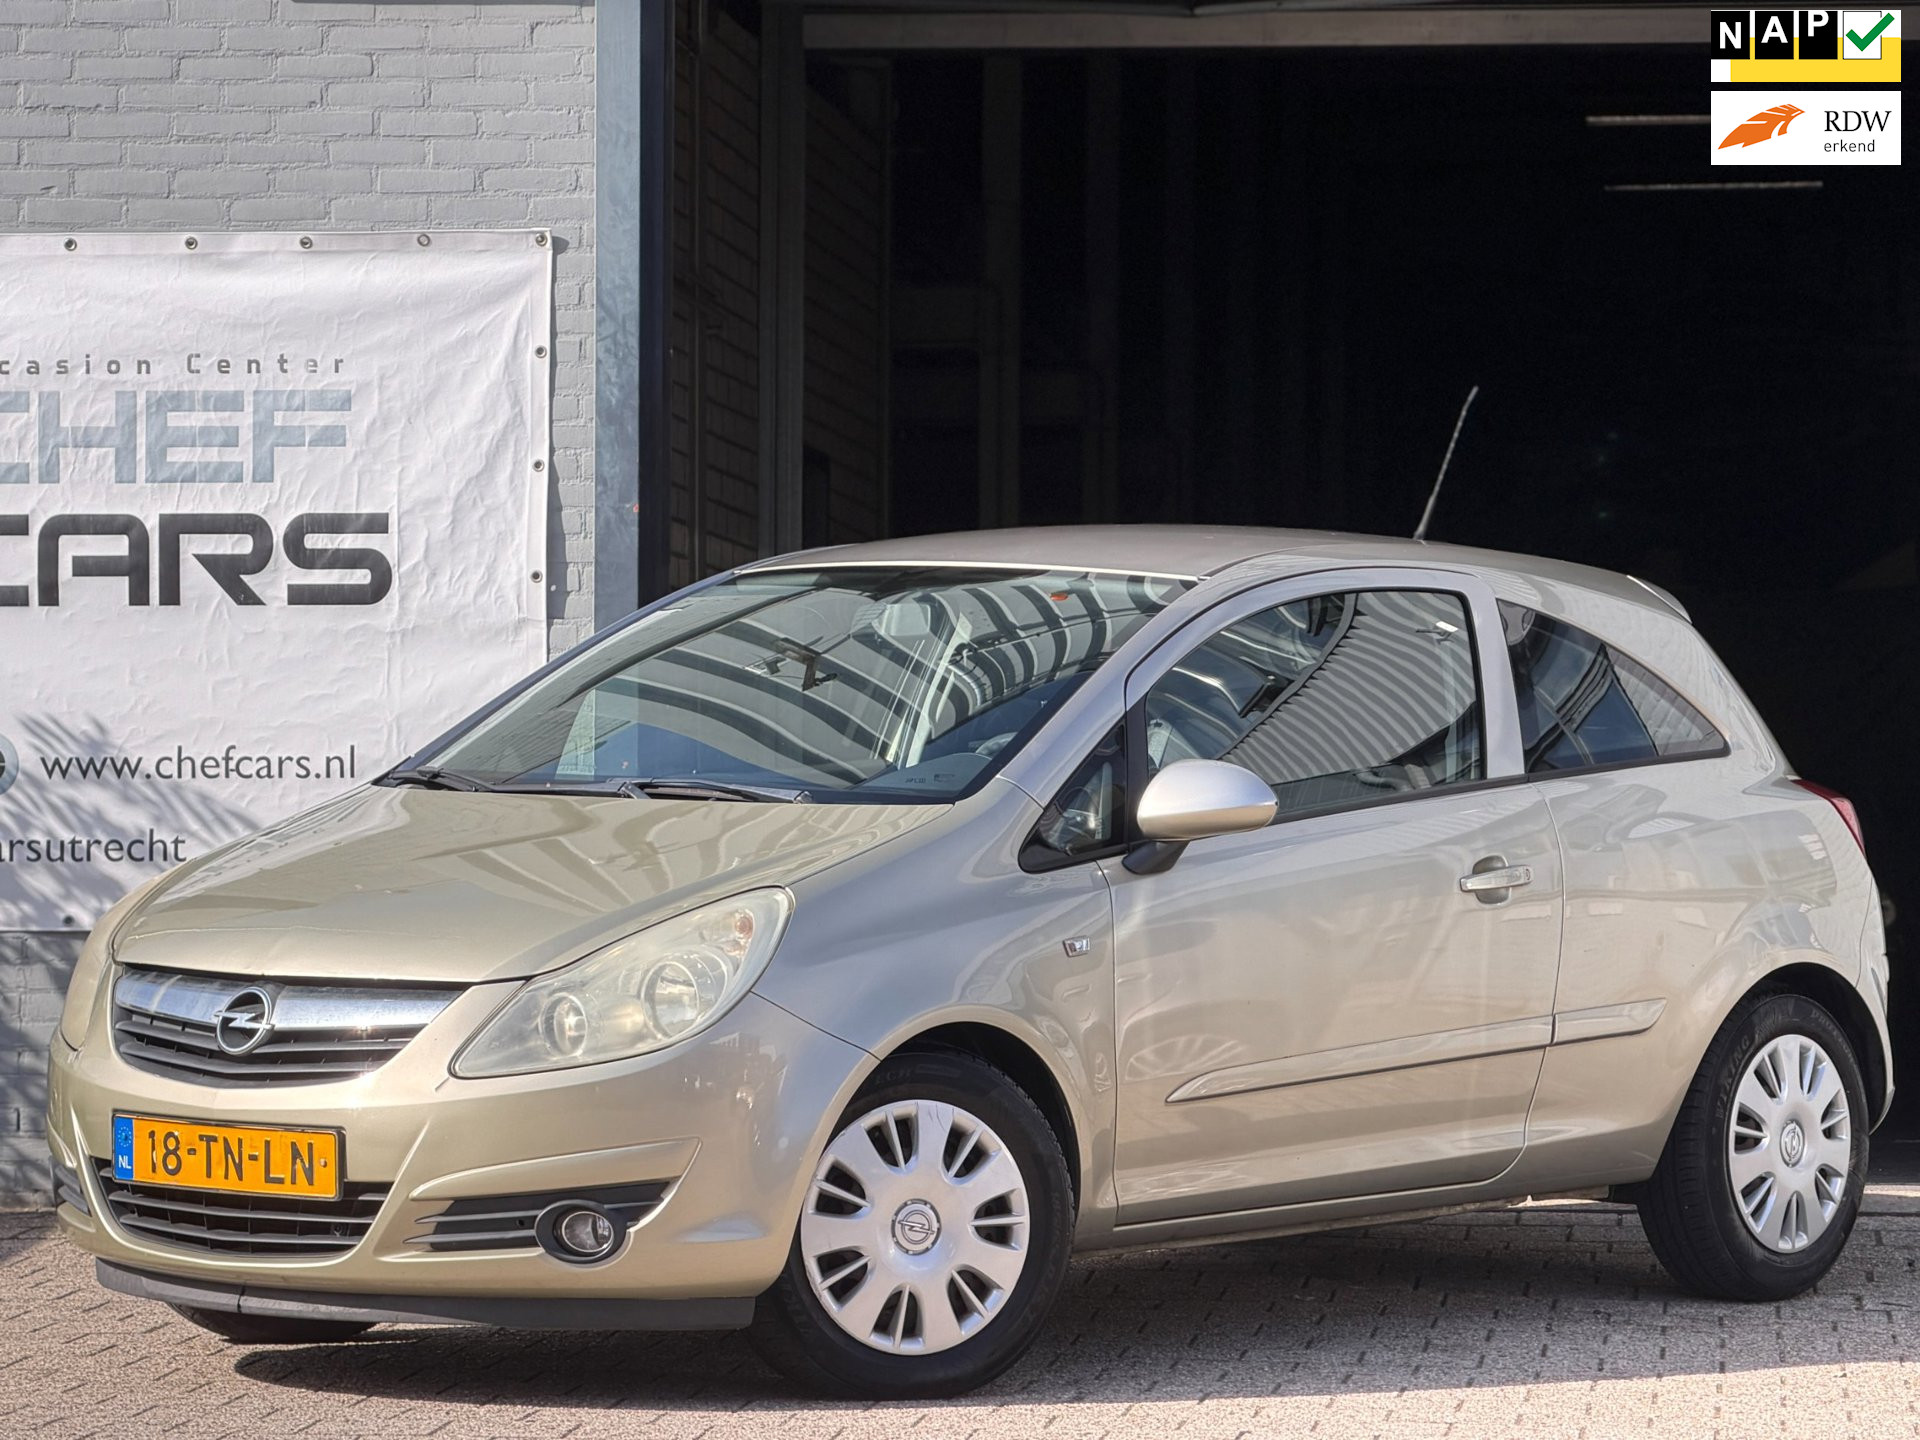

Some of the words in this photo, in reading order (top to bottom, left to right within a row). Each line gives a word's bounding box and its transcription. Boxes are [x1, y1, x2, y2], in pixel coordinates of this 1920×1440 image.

[186, 353, 345, 375] Center
[0, 513, 392, 607] ARS
[40, 744, 356, 780] www.chefcars.nl
[0, 828, 187, 863] rsutrecht
[118, 1155, 132, 1169] NL
[148, 1130, 314, 1186] 18-TN-LN
